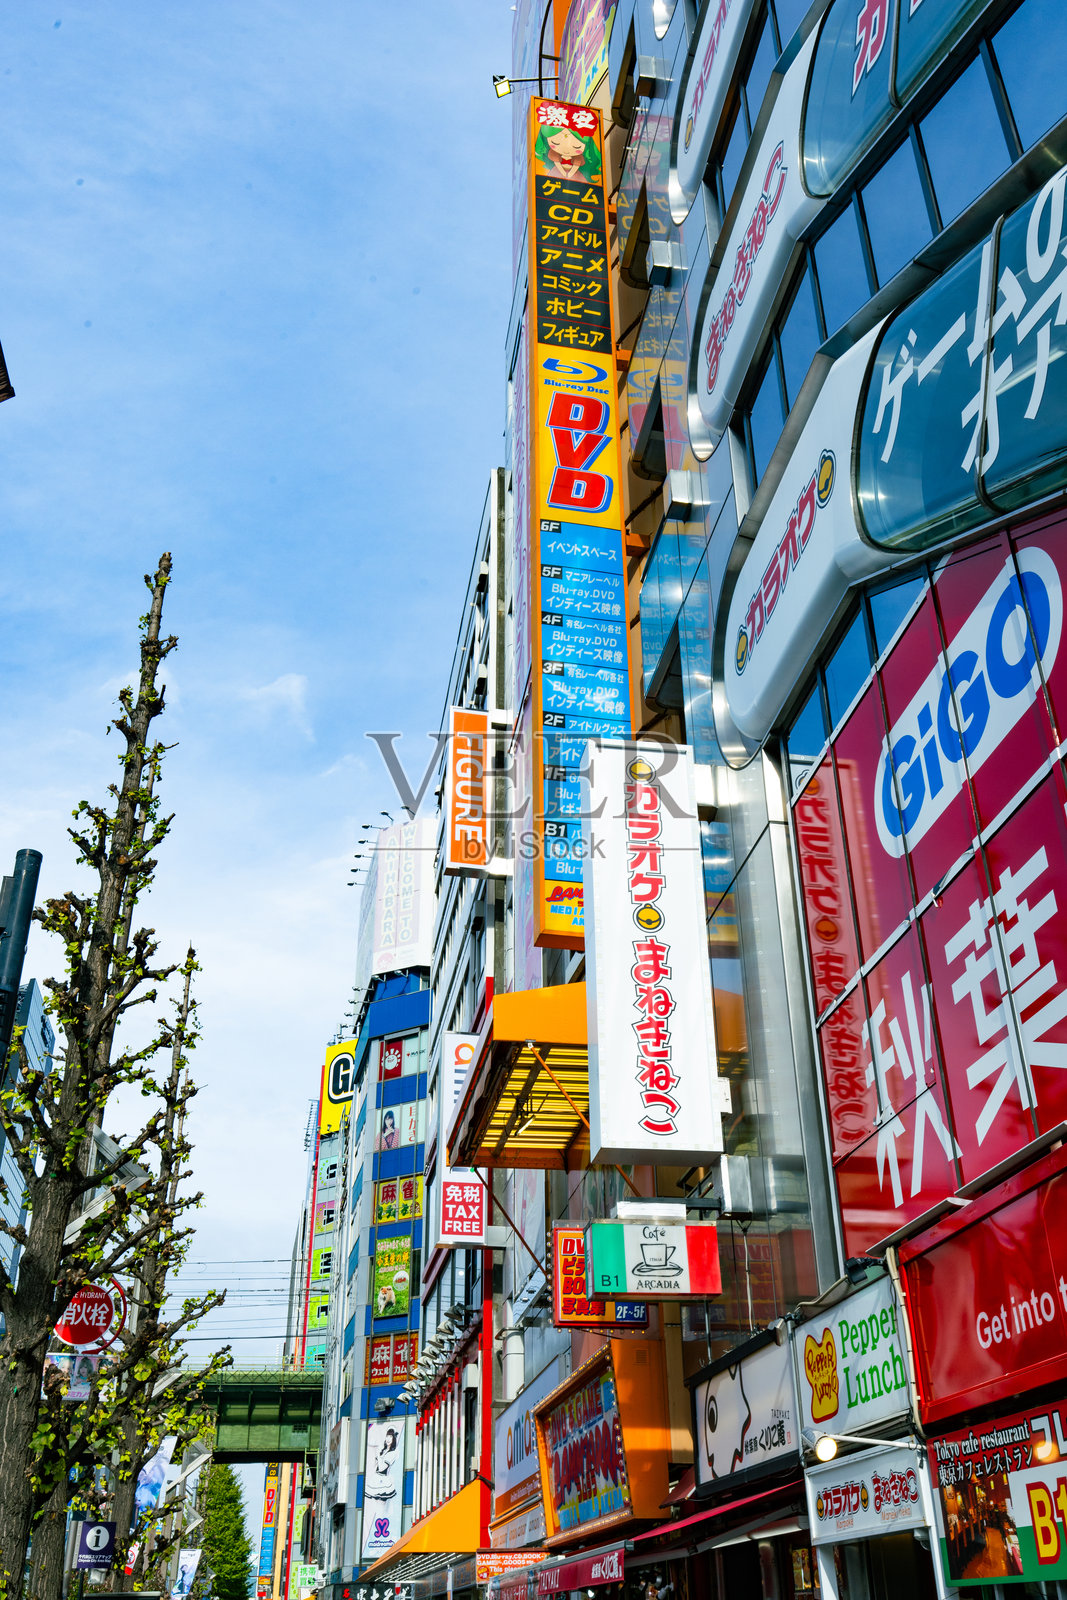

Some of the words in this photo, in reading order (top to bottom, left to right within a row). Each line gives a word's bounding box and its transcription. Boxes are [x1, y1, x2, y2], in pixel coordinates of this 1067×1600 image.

[541, 179, 599, 204] ゲーム
[548, 204, 594, 225] CD
[541, 224, 602, 249] アイドル
[540, 248, 605, 273] アニメ
[705, 141, 788, 394] まねきねこ
[542, 273, 602, 297] コミック
[545, 297, 601, 319] ホビー
[542, 322, 604, 348] フィギュア
[543, 379, 584, 392] Blu-ray
[546, 390, 613, 513] DVD
[540, 521, 560, 532] 6F
[547, 541, 616, 561] イベントスペース
[541, 566, 561, 578] 5F
[745, 473, 818, 653] カラオケ
[565, 571, 620, 587] マニアレーベル
[546, 597, 621, 616] インディーズ映像
[542, 614, 562, 626] 4F
[566, 620, 622, 635] 有名レーベル各社
[546, 644, 623, 663] インディーズ映像
[542, 662, 563, 674] 3F
[547, 695, 625, 715] インディーズ映像
[882, 571, 1051, 838] GiGO
[543, 714, 564, 726] 2F
[568, 719, 625, 734] アイドルグッズ
[454, 731, 483, 843] FIGURE
[545, 822, 566, 836] B1
[624, 784, 666, 903] カラオケ
[632, 936, 681, 1135] まねきねこ
[446, 1184, 480, 1203] 免税
[446, 1205, 480, 1220] TAX
[445, 1221, 480, 1233] FREE
[601, 1275, 619, 1287] B1
[636, 1280, 680, 1290] ARCADIA
[562, 1298, 605, 1316] 写真集
[976, 1304, 1011, 1349] Get
[1010, 1289, 1055, 1334] into
[843, 1343, 907, 1408] Lunch
[934, 1440, 960, 1461] Tokyo
[962, 1431, 979, 1456] cafe
[980, 1419, 1031, 1448] restaurant
[938, 1445, 1033, 1487] 東京カフェレストラン
[823, 1483, 861, 1518] カラオケ
[871, 1468, 919, 1514] まねきねこ
